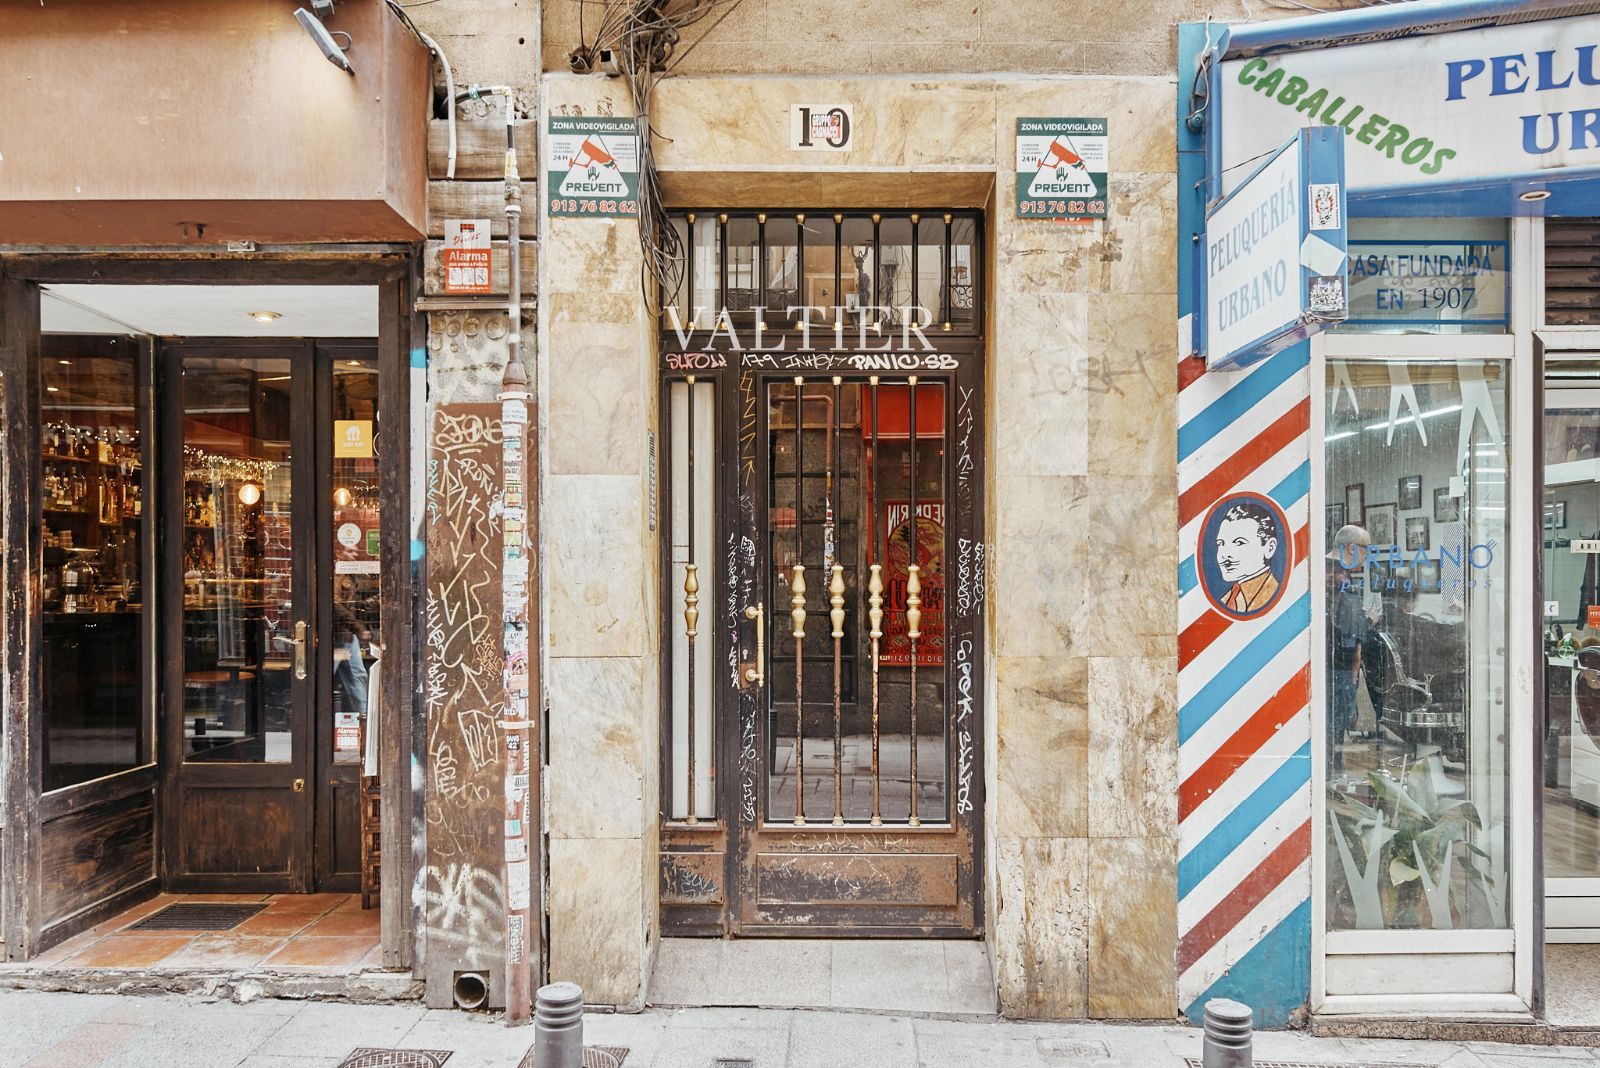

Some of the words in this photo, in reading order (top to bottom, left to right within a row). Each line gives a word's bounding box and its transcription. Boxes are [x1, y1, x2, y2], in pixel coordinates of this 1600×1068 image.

[552, 122, 575, 130] ZONA
[576, 122, 635, 130] VIDEOVIGILADA
[1238, 57, 1456, 175] CABALLEROS
[799, 108, 850, 148] 10
[1021, 123, 1043, 131] ZONA
[1044, 123, 1103, 131] VIDEOVIGILADA
[1519, 108, 1600, 154] UR
[566, 183, 622, 192] PREVENT
[1034, 183, 1090, 193] PREVENT
[552, 199, 577, 212] 913
[580, 200, 597, 213] 76
[600, 200, 616, 213] 82
[619, 201, 636, 213] 62
[1021, 201, 1045, 213] 913
[1048, 201, 1066, 213] 76
[1068, 201, 1085, 213] 82
[1087, 201, 1104, 213] 62
[1210, 170, 1296, 278] PELUQUERÍA
[449, 251, 488, 261] Alarma
[1398, 255, 1494, 276] FUNDADA
[1219, 259, 1287, 332] URBANO
[1377, 288, 1405, 310] EN
[1418, 287, 1476, 309] 1907
[1339, 543, 1495, 569] URBANO
[1339, 573, 1493, 593] peluqueros
